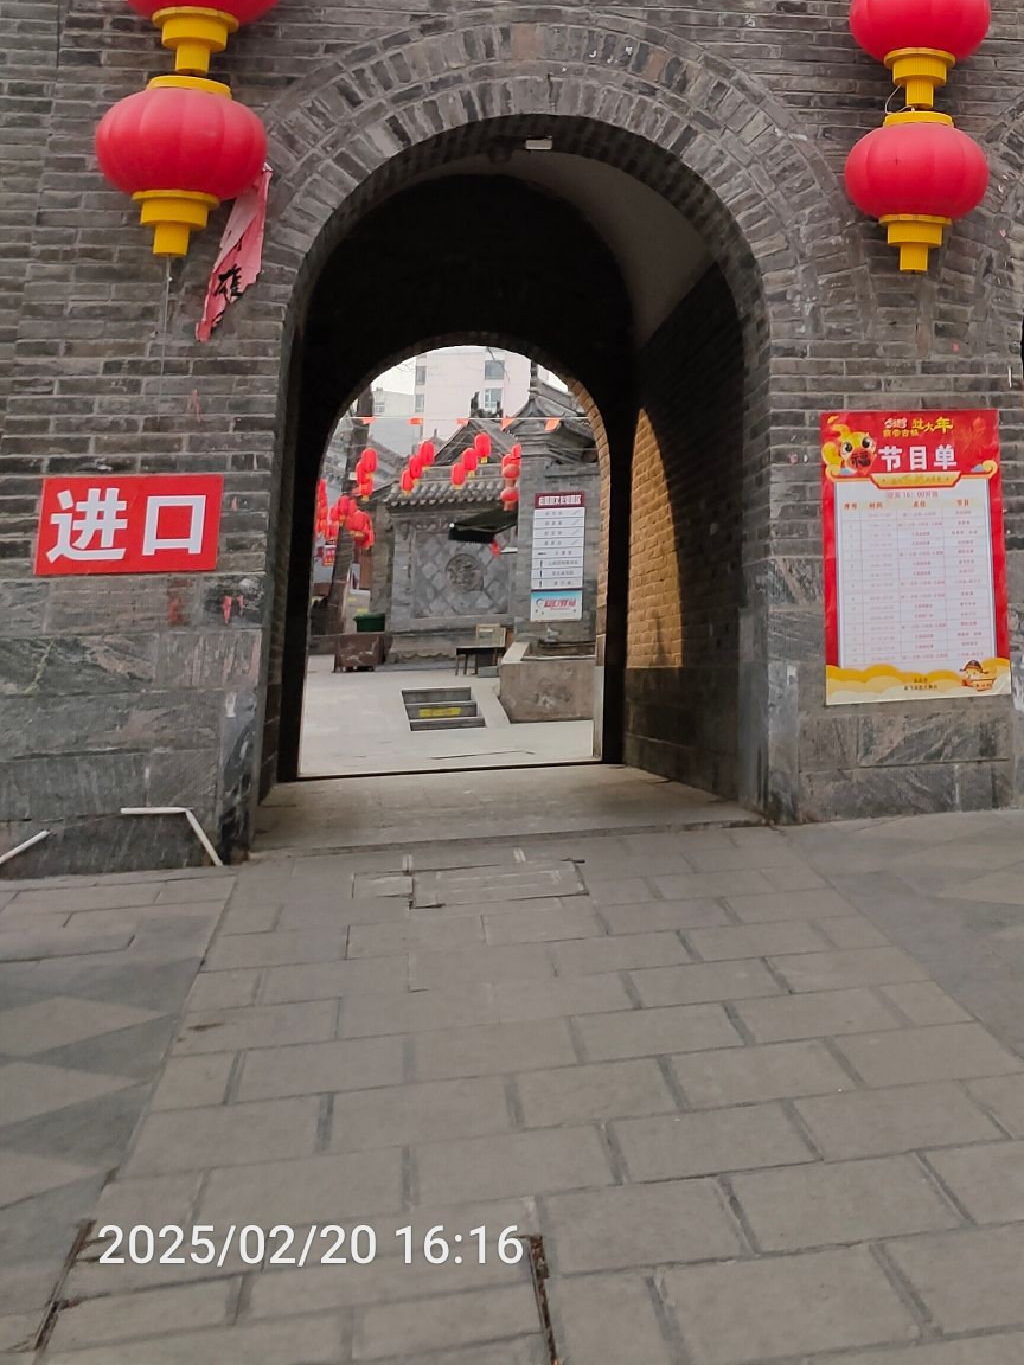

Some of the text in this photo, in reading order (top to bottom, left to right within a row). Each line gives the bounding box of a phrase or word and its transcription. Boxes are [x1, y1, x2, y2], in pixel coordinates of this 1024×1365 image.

[878, 444, 957, 472] 节目单
[45, 487, 207, 563] 进口
